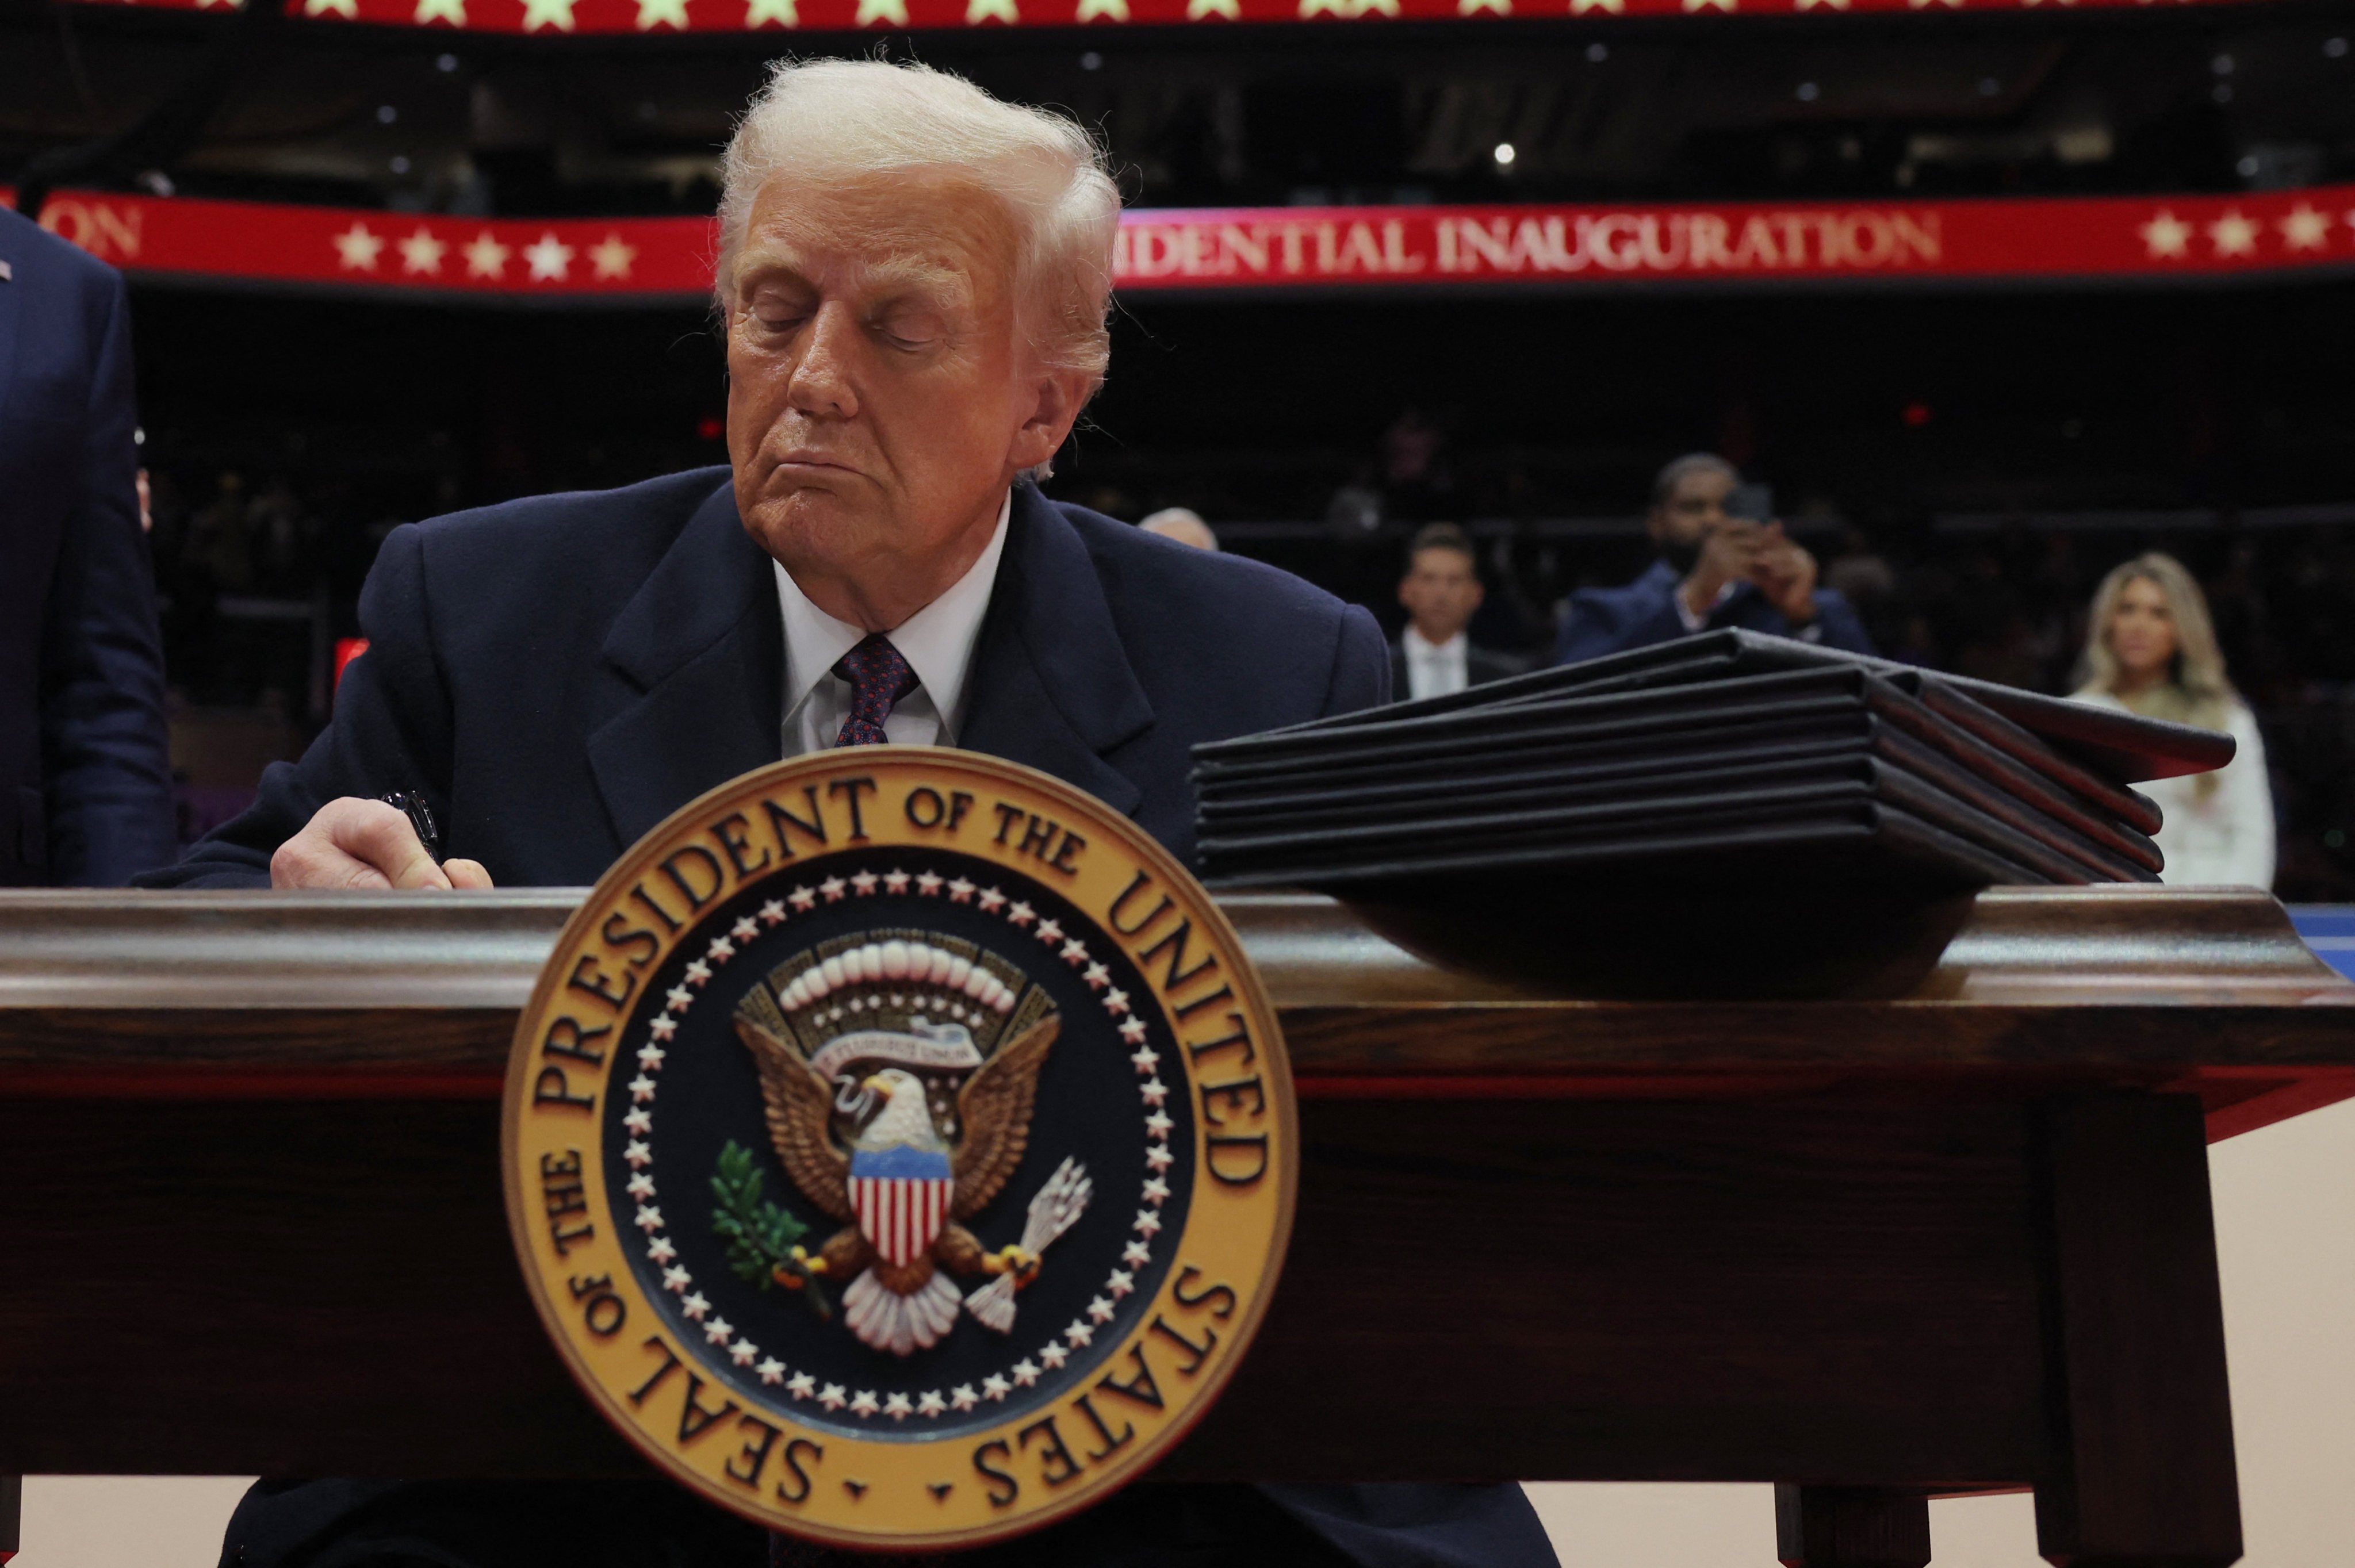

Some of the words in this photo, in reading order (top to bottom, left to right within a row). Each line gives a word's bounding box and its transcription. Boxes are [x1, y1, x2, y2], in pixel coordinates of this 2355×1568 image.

[38, 200, 142, 259] ON
[1437, 209, 1942, 273] INAUGURATION
[904, 786, 974, 832] OF
[994, 802, 1087, 877] THE
[533, 776, 877, 1114] PRESIDENT
[1108, 869, 1269, 1188] UNITED
[540, 1148, 595, 1257] THE
[568, 1271, 627, 1337] OF
[628, 1335, 823, 1504] SEAL
[971, 1265, 1237, 1508] STATES
